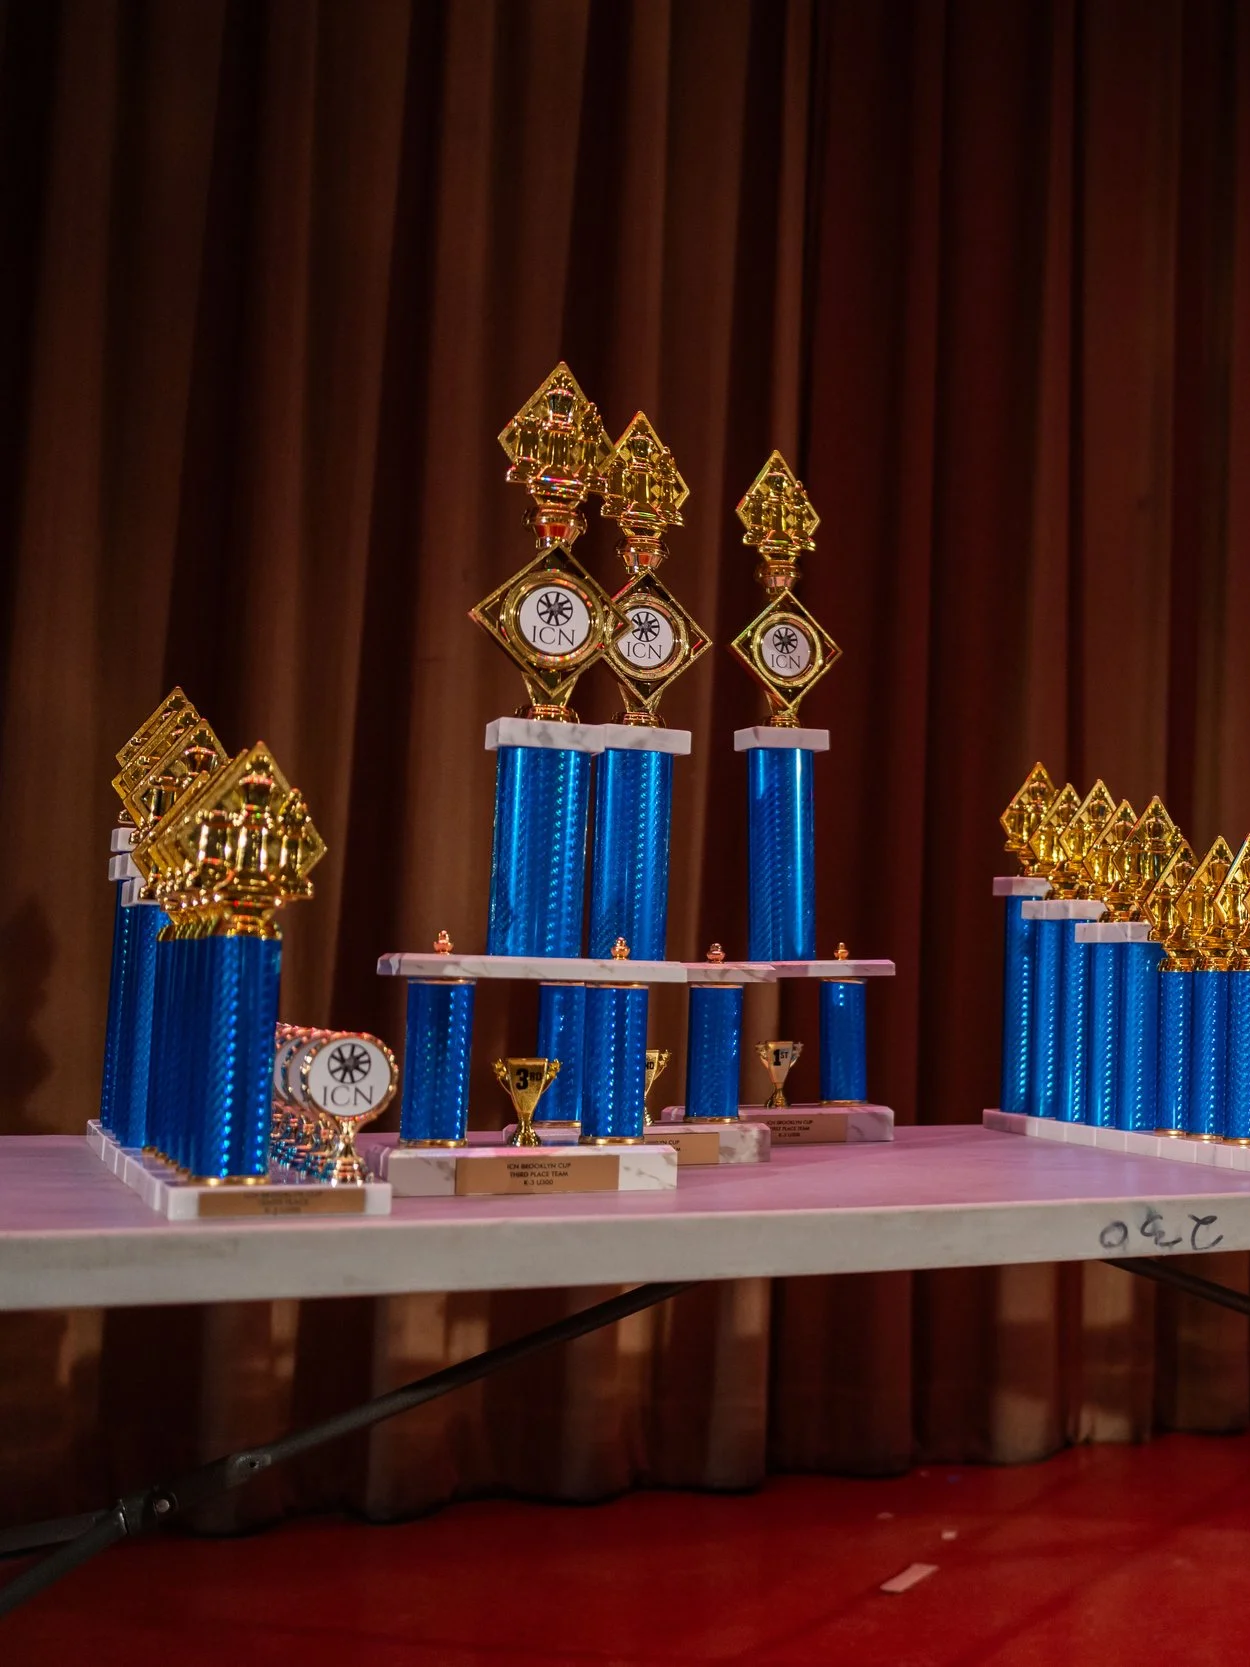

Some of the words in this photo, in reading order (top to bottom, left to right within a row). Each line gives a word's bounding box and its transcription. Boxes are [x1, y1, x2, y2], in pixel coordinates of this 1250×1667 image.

[531, 625, 576, 647] ICN
[627, 641, 663, 660] ICN
[771, 654, 801, 669] ICN
[773, 1049, 789, 1066] 1ST
[516, 1068, 543, 1090] 3RD
[322, 1085, 374, 1107] ICN
